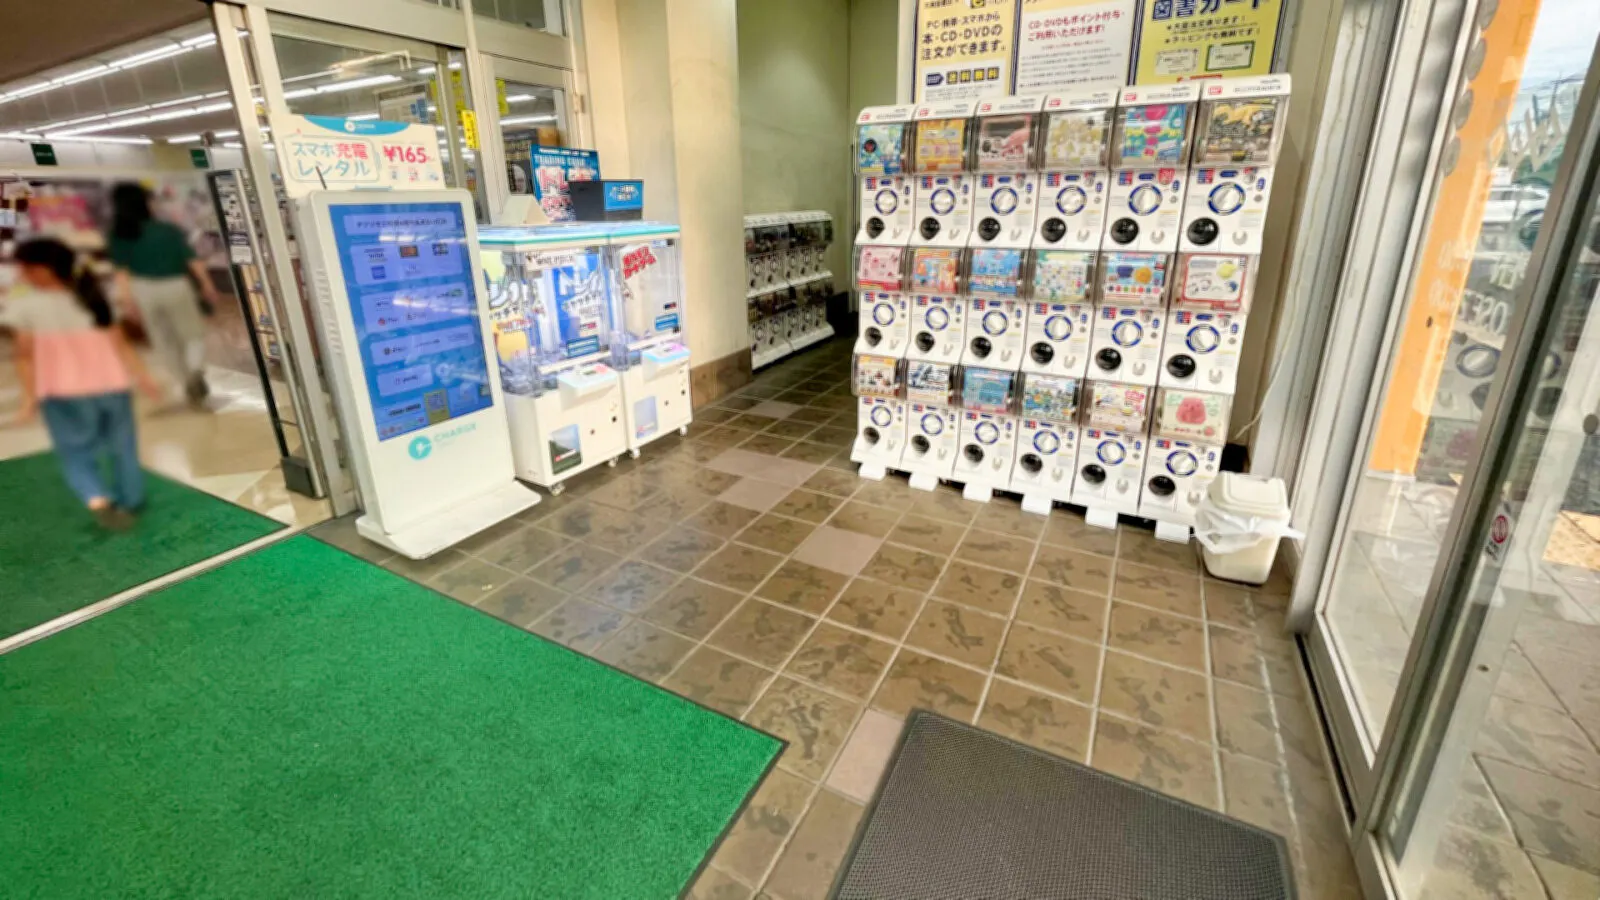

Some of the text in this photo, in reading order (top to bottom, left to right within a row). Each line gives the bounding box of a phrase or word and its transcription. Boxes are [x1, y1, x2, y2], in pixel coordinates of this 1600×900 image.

[293, 141, 369, 161] スマホ充電
[382, 144, 427, 164] ¥165
[298, 158, 371, 177] レンタル
